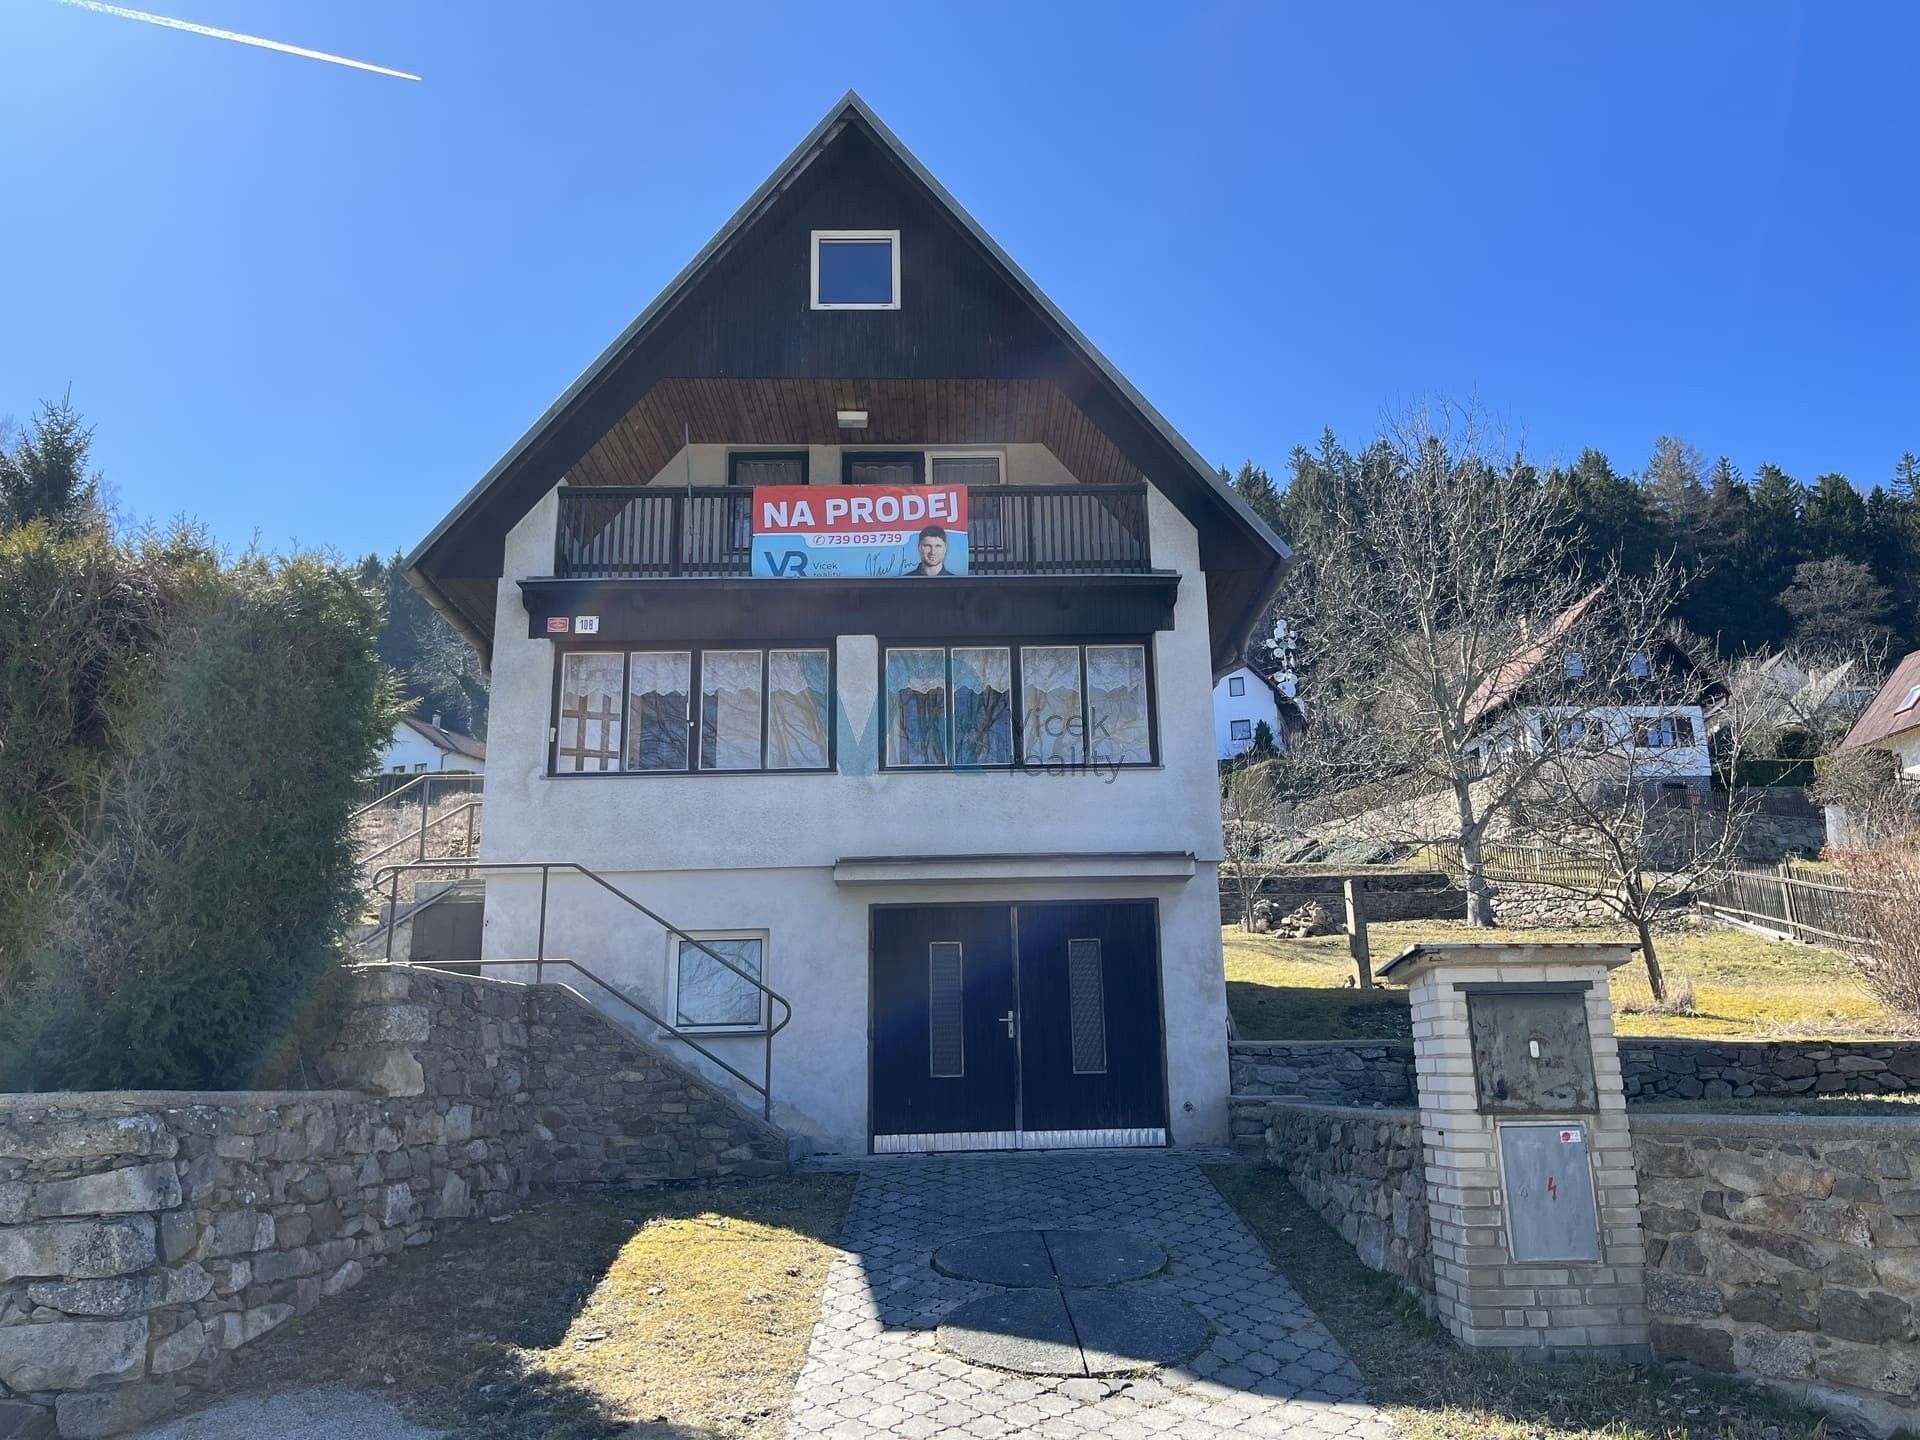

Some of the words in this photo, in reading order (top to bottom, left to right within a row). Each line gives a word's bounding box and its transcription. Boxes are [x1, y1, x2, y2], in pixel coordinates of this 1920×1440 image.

[763, 500, 816, 529] NA
[825, 491, 959, 525] PRODEJ
[828, 535, 850, 545] 739
[853, 534, 877, 544] 093
[880, 533, 902, 543] 739
